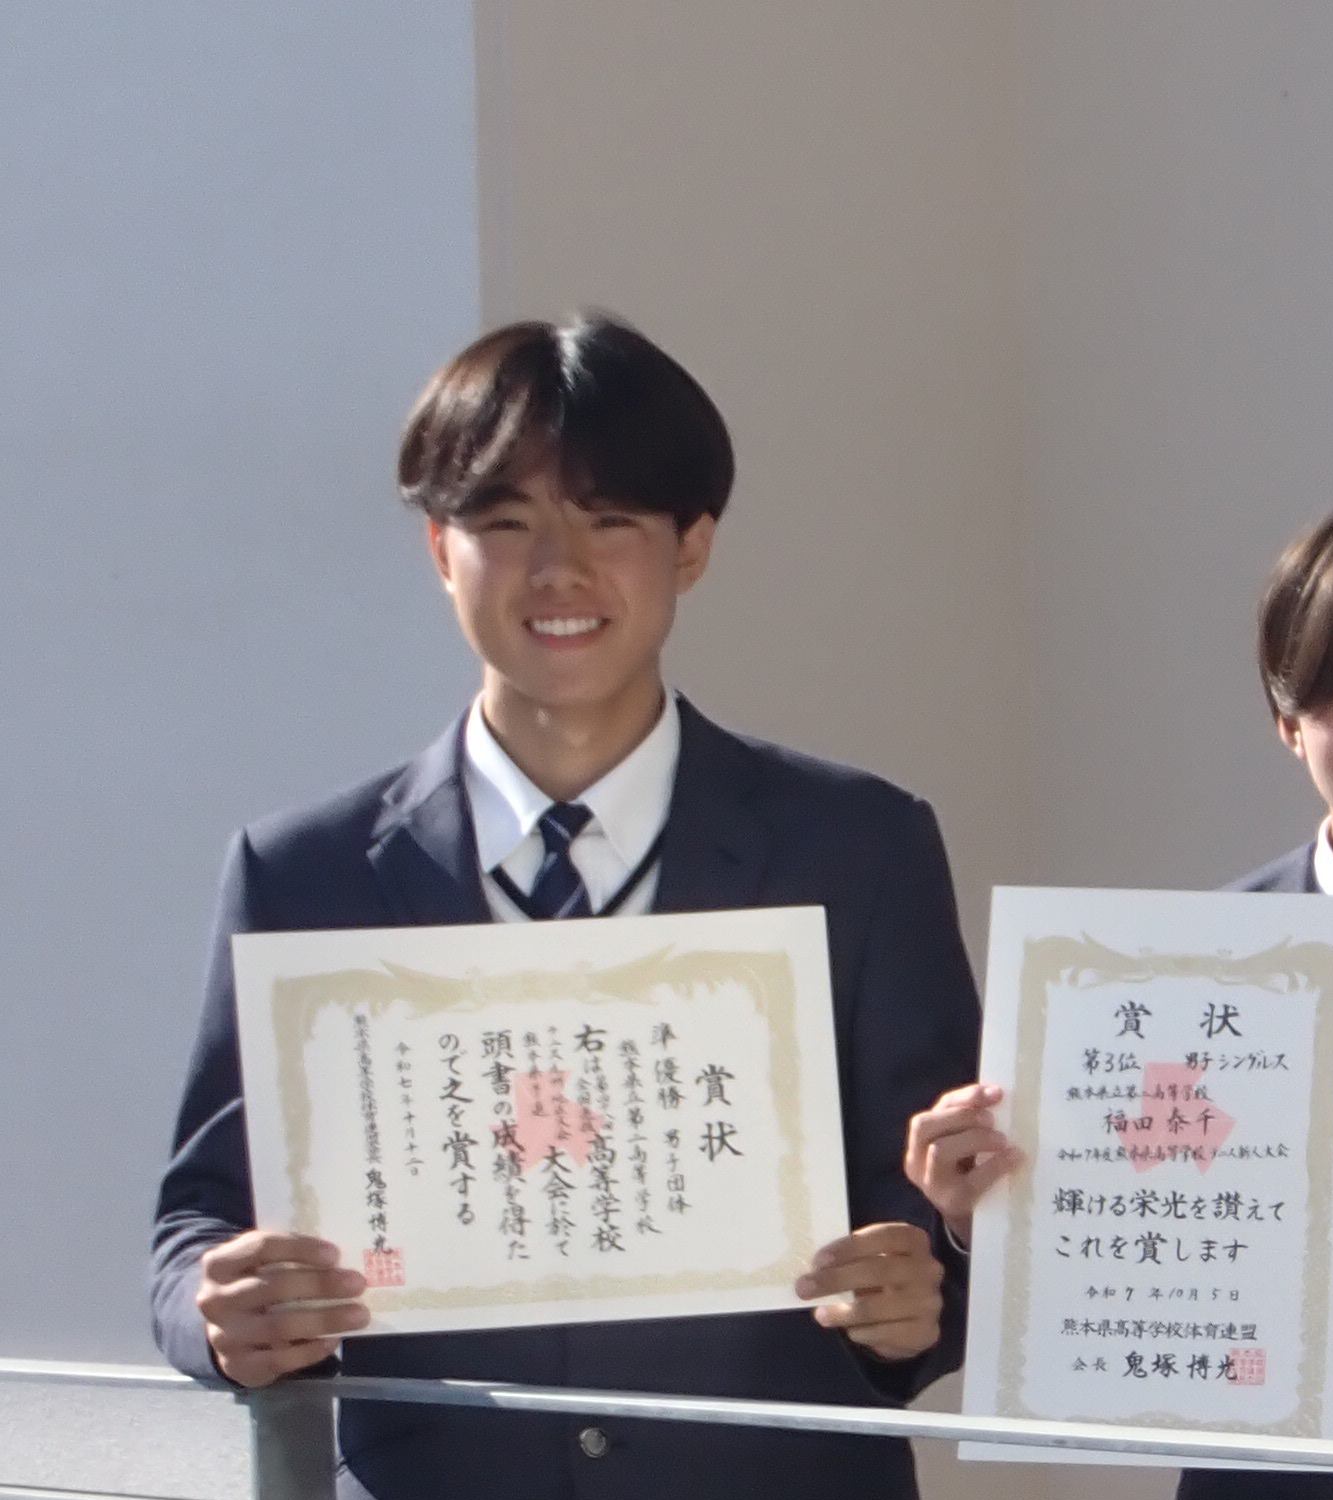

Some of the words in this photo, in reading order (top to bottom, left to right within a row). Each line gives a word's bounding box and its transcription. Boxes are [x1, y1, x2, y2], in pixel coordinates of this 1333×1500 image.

[1114, 1000, 1243, 1039] 賞状
[1082, 1048, 1142, 1075] 第3位
[1184, 1050, 1289, 1072] 男子シングルス
[695, 1064, 744, 1162] 賞状
[1052, 1188, 1285, 1221] 輝ける栄光を讃えて
[1055, 1231, 1248, 1265] これを賞します
[1071, 1356, 1109, 1373] 会長
